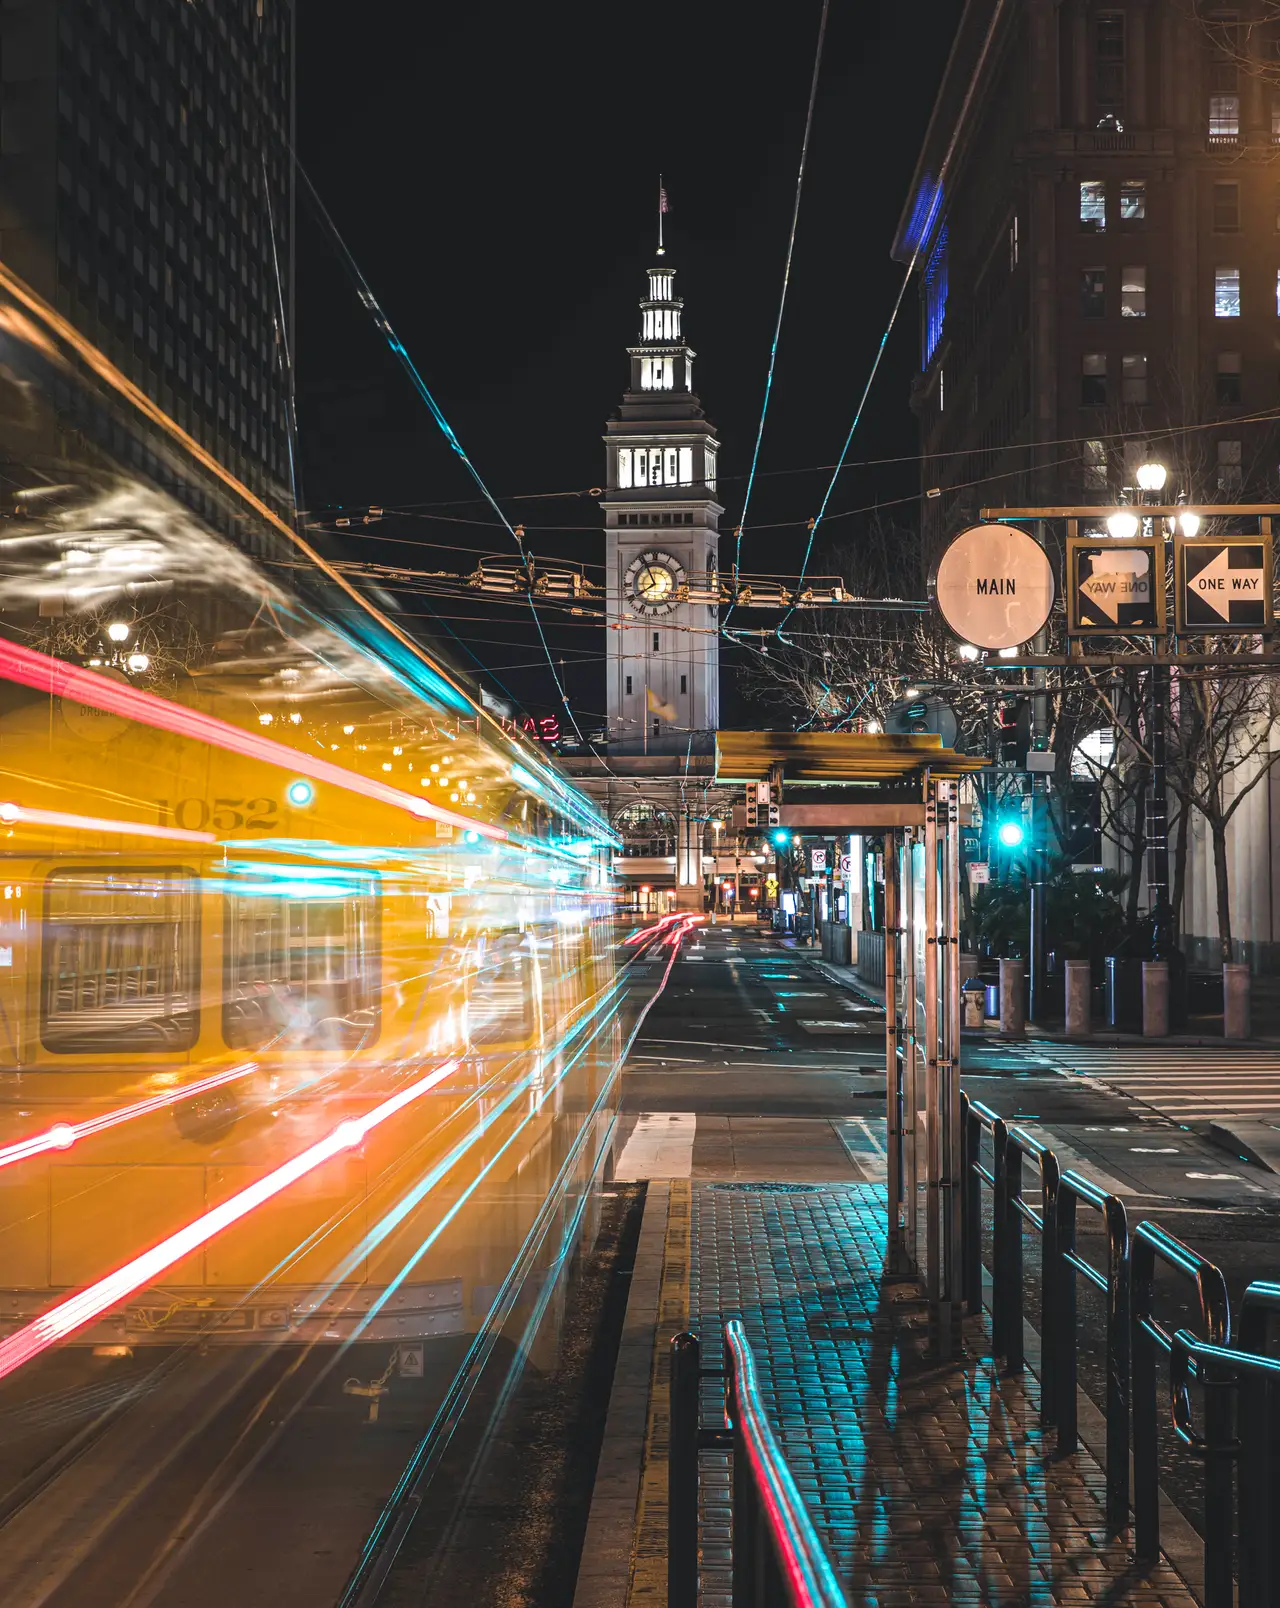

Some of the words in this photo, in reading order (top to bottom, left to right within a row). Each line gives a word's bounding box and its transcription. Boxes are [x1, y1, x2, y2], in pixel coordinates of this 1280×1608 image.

[976, 578, 1016, 595] MAIN
[1198, 578, 1225, 590] ONE
[1231, 578, 1259, 590] WAY
[152, 797, 279, 831] 1052
